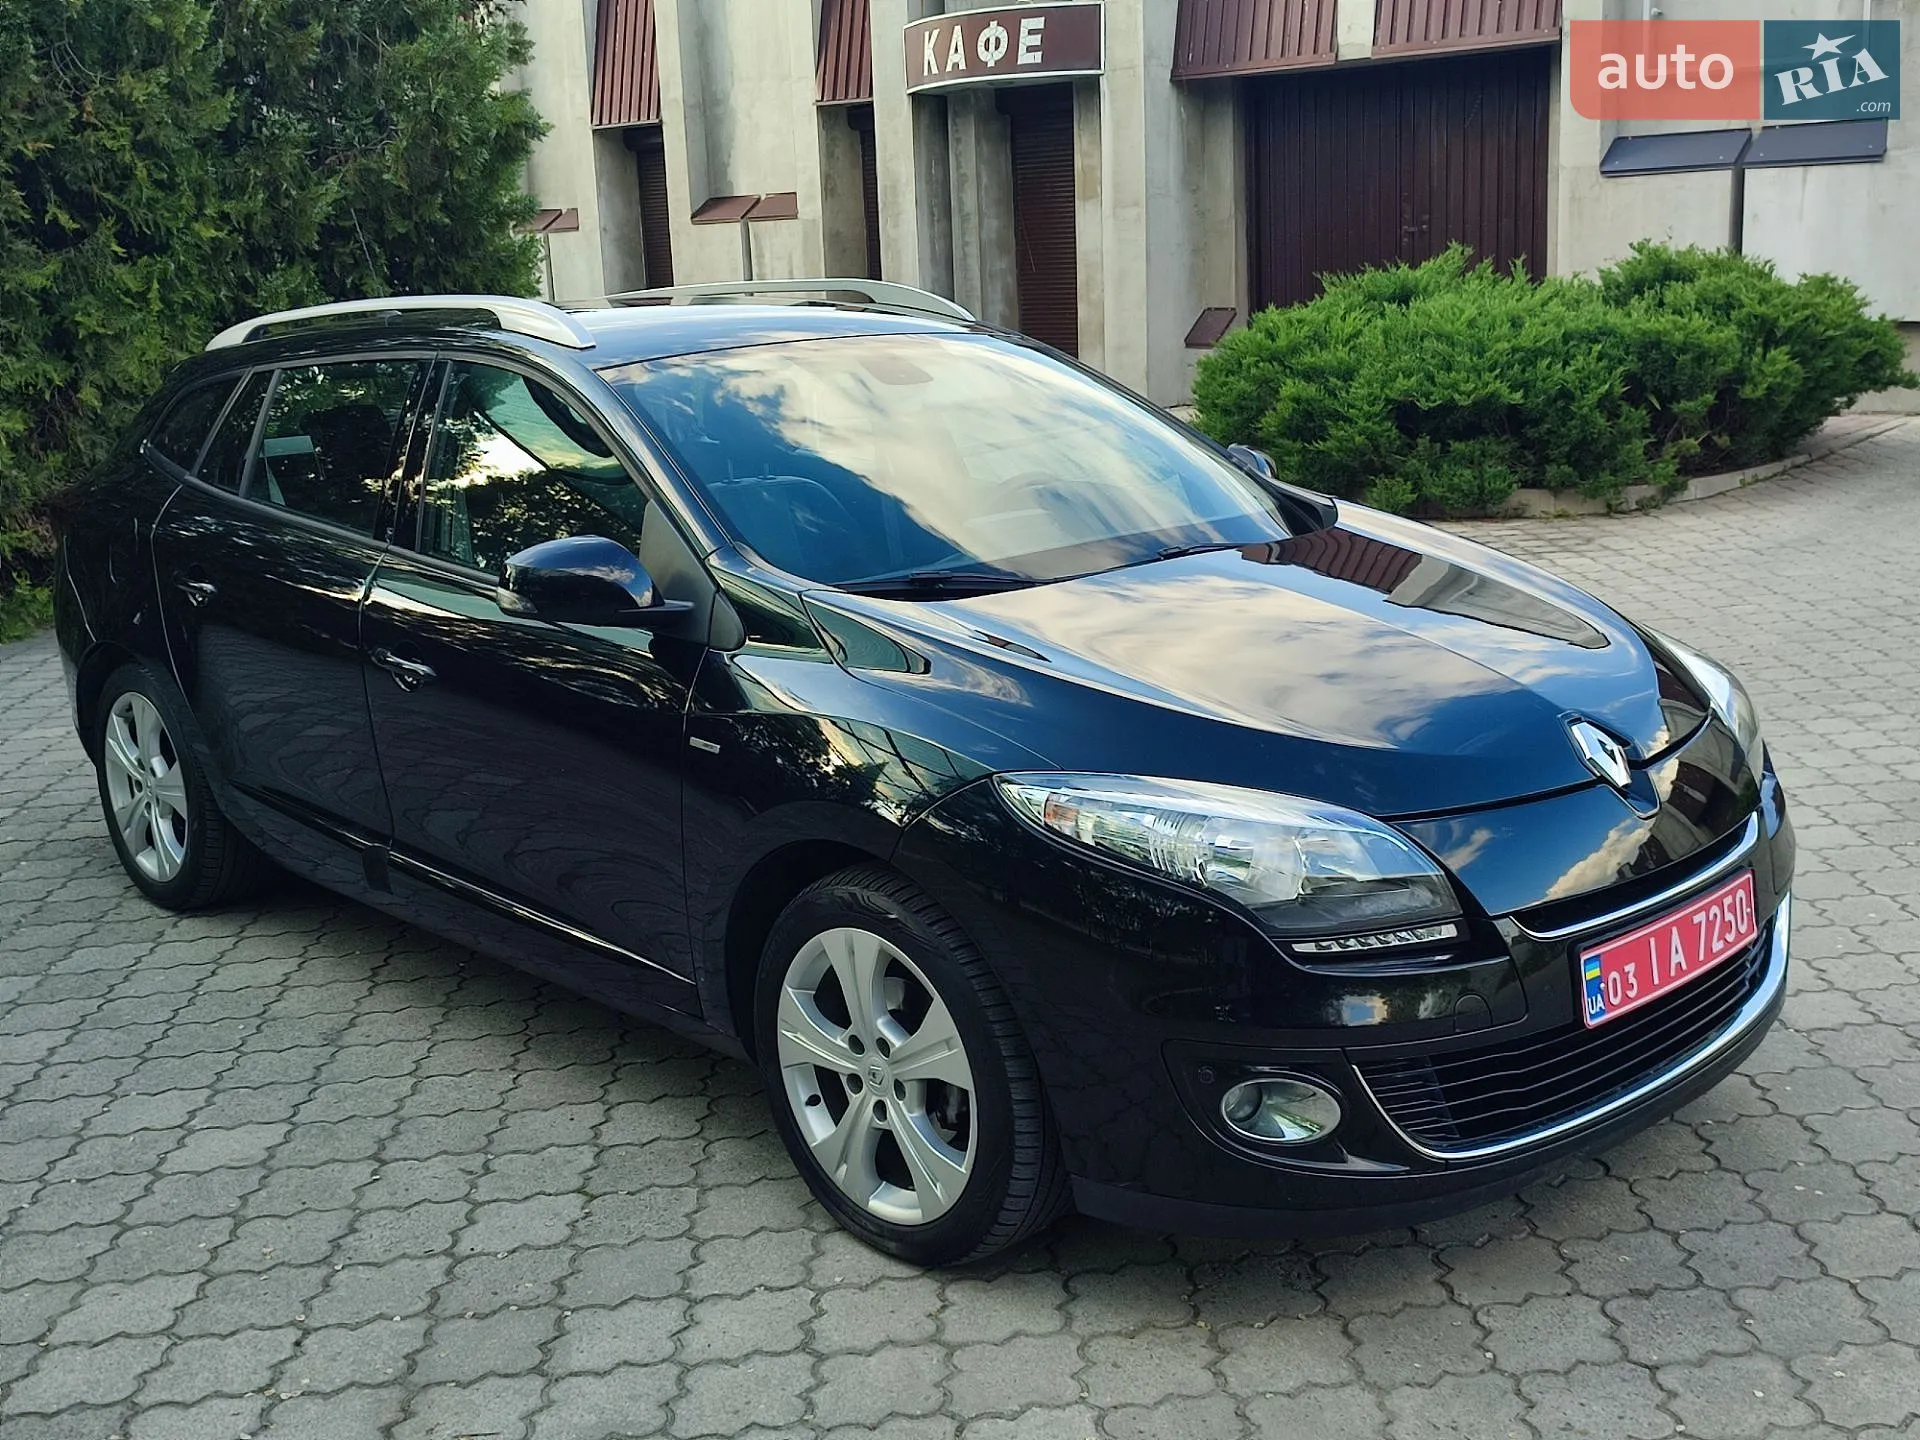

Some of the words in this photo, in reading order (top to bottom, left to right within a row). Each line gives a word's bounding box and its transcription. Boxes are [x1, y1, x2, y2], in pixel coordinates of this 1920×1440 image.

[923, 17, 1045, 76] КАФЕ
[1607, 962, 1638, 1006] 03
[1650, 926, 1687, 985] IA
[1692, 888, 1748, 962] 7250
[1588, 994, 1606, 1014] UA
